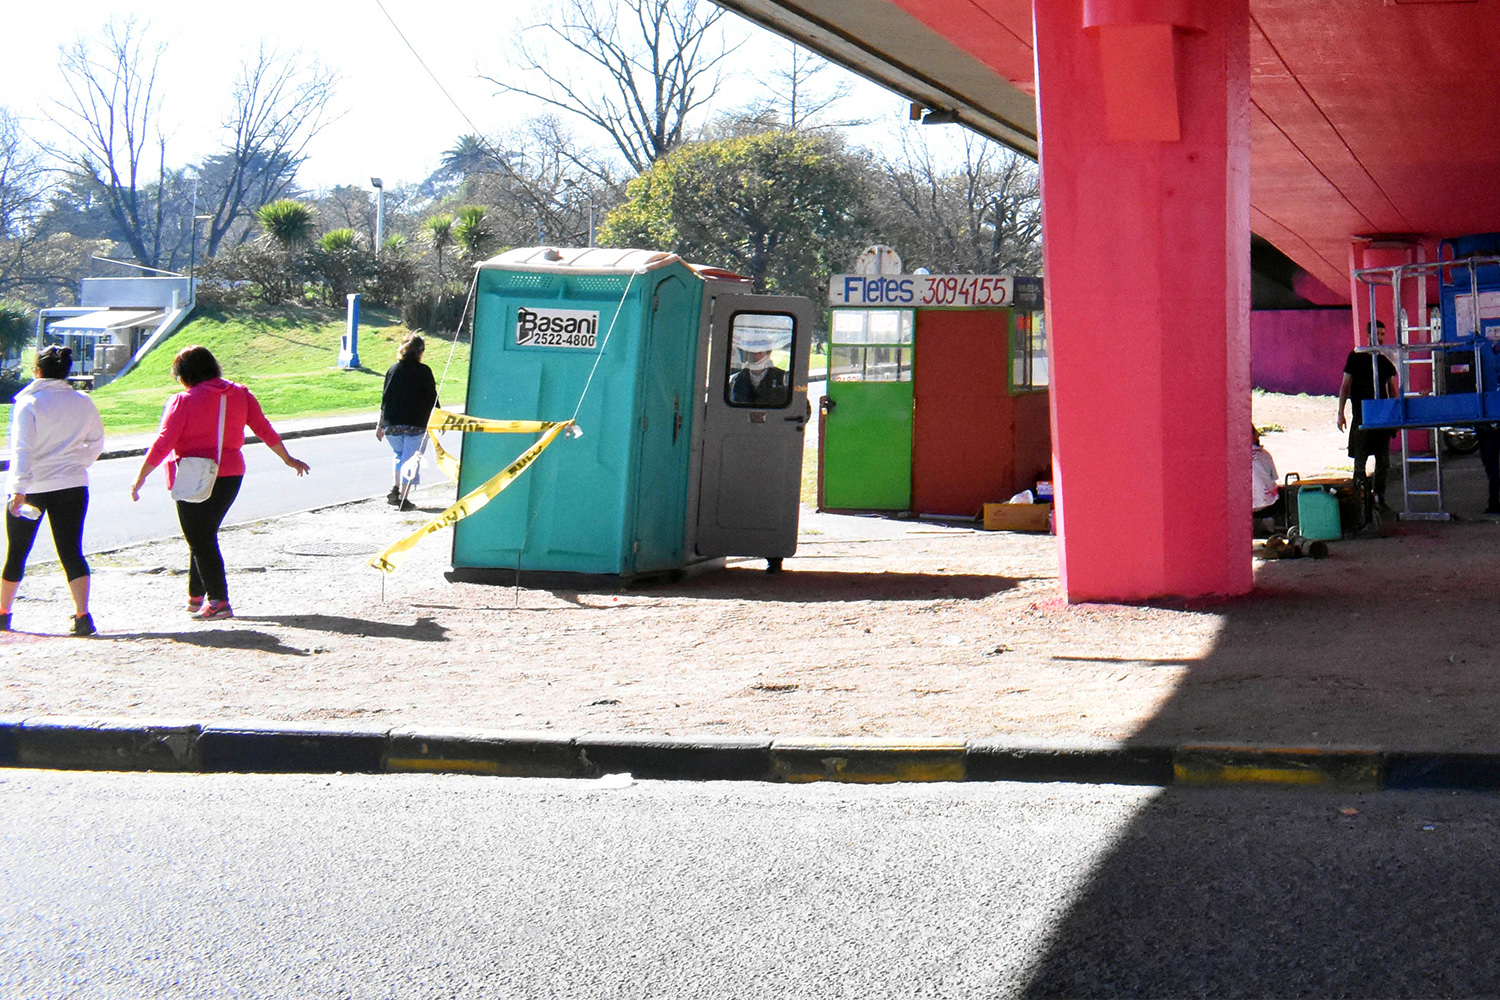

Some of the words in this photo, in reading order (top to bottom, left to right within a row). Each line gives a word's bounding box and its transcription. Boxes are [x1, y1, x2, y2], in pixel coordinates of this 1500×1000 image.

[844, 276, 914, 303] Fletes
[922, 277, 1006, 305] 3094155
[521, 311, 597, 334] Basani
[534, 332, 595, 346] 2522-4800
